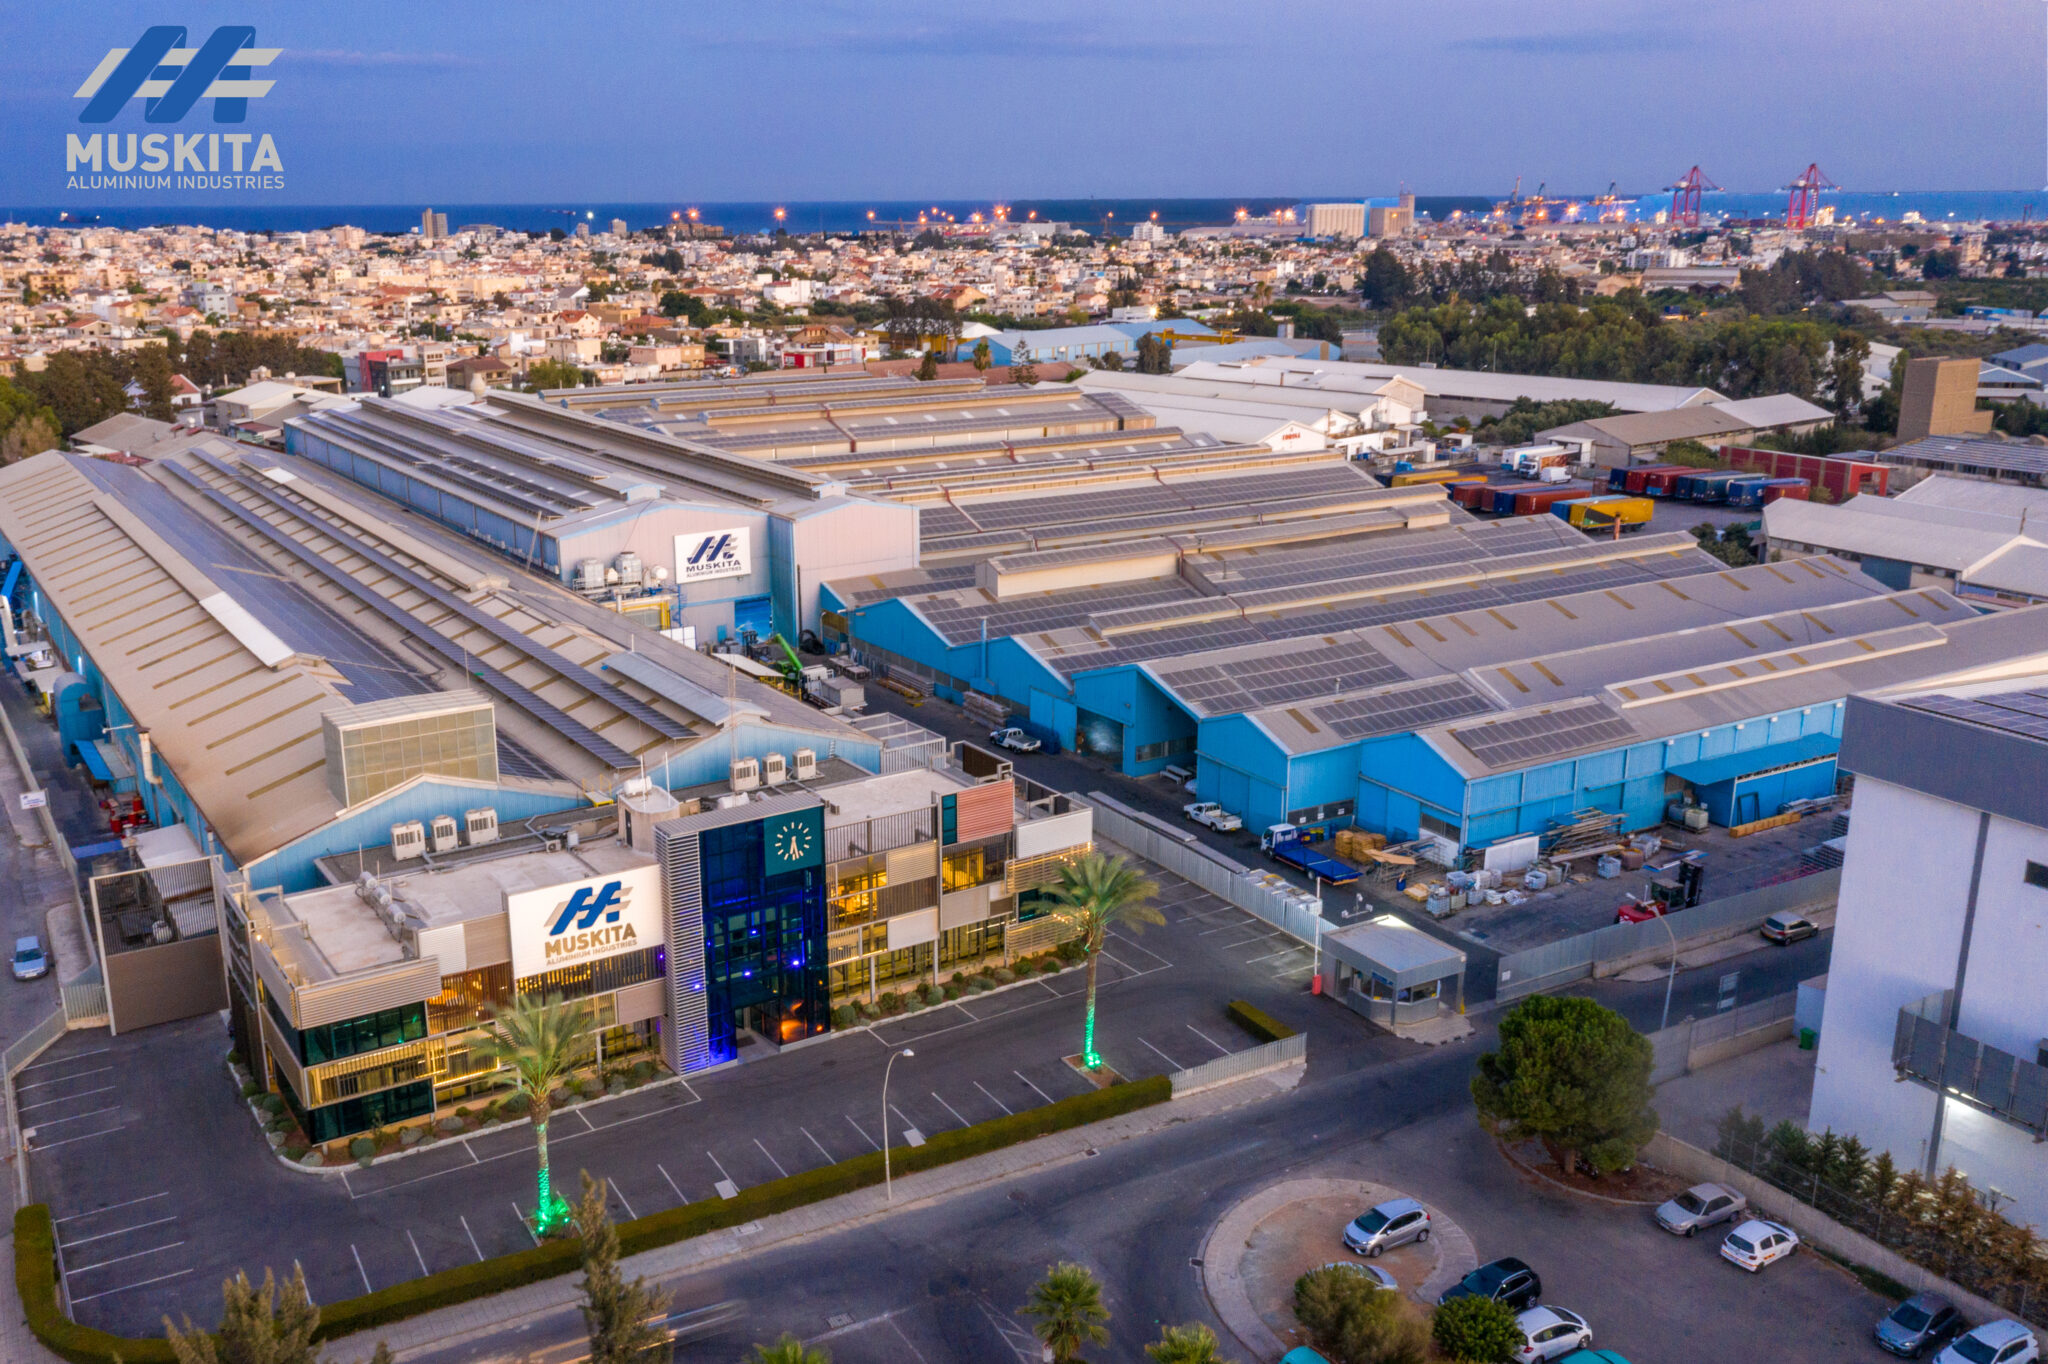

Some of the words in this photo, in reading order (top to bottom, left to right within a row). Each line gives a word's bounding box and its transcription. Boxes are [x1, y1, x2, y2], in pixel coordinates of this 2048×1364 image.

[686, 560, 741, 573] MUSKITA
[544, 922, 637, 958] MUSKITA
[546, 949, 591, 966] ALUMINIUM
[592, 939, 638, 956] INDUSTRIES
